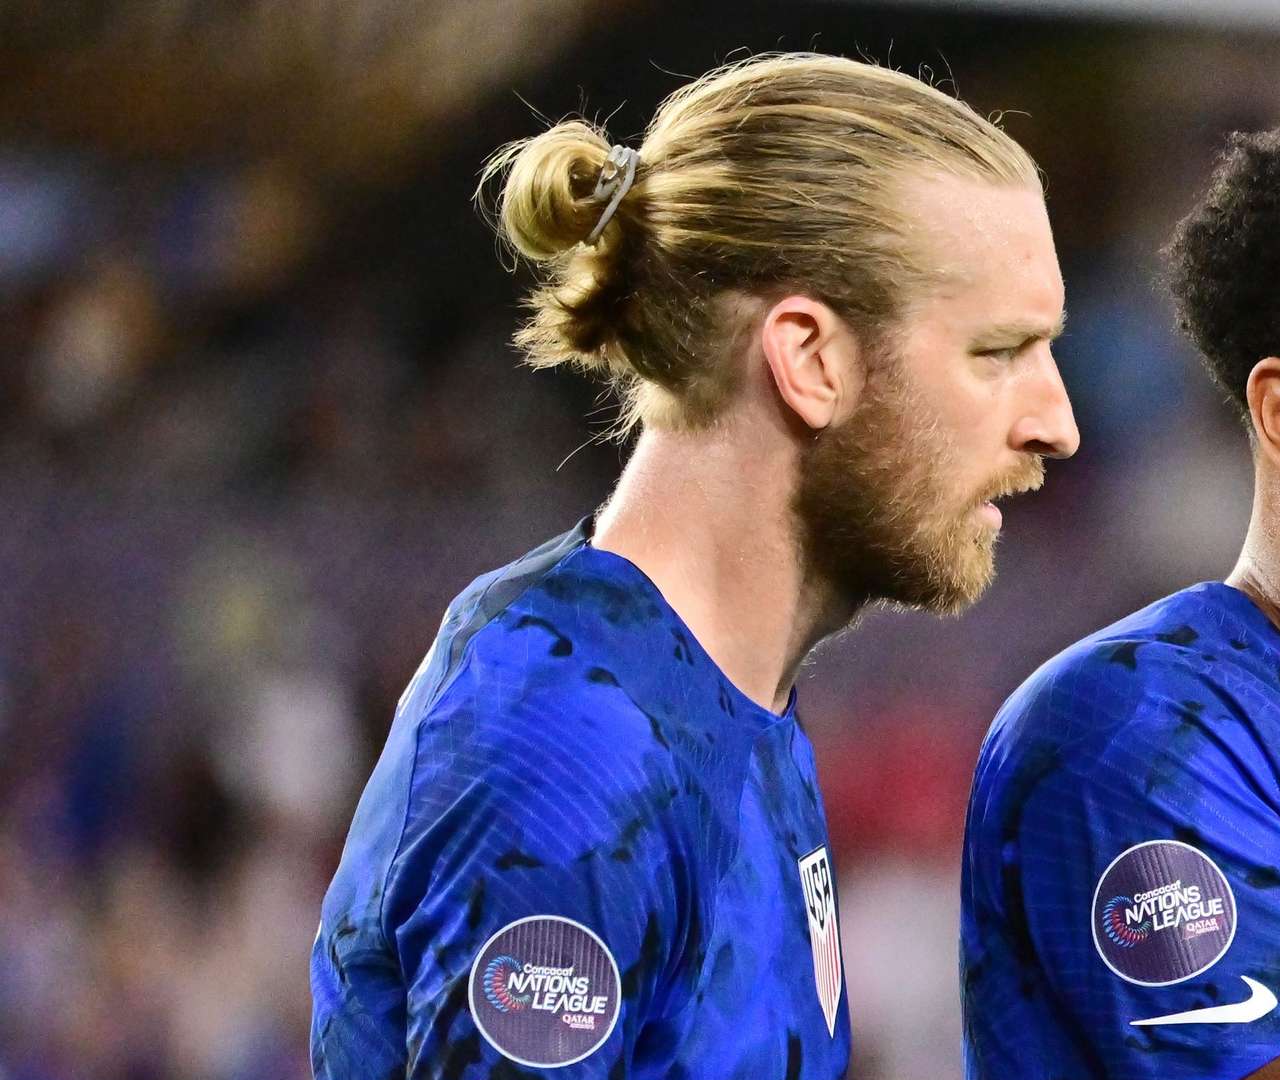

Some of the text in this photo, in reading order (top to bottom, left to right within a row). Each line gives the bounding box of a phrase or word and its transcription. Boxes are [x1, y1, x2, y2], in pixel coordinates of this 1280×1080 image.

[802, 858, 831, 931] USA
[1133, 879, 1181, 903] Concacaf
[1125, 886, 1201, 926] NATIONS
[1152, 898, 1224, 932] LEAGUE
[1186, 917, 1218, 932] QATAR
[523, 963, 574, 977] Concacaf
[507, 971, 590, 995] NATIONS
[531, 993, 608, 1014] LEAGUE
[562, 1013, 595, 1025] QATAR
